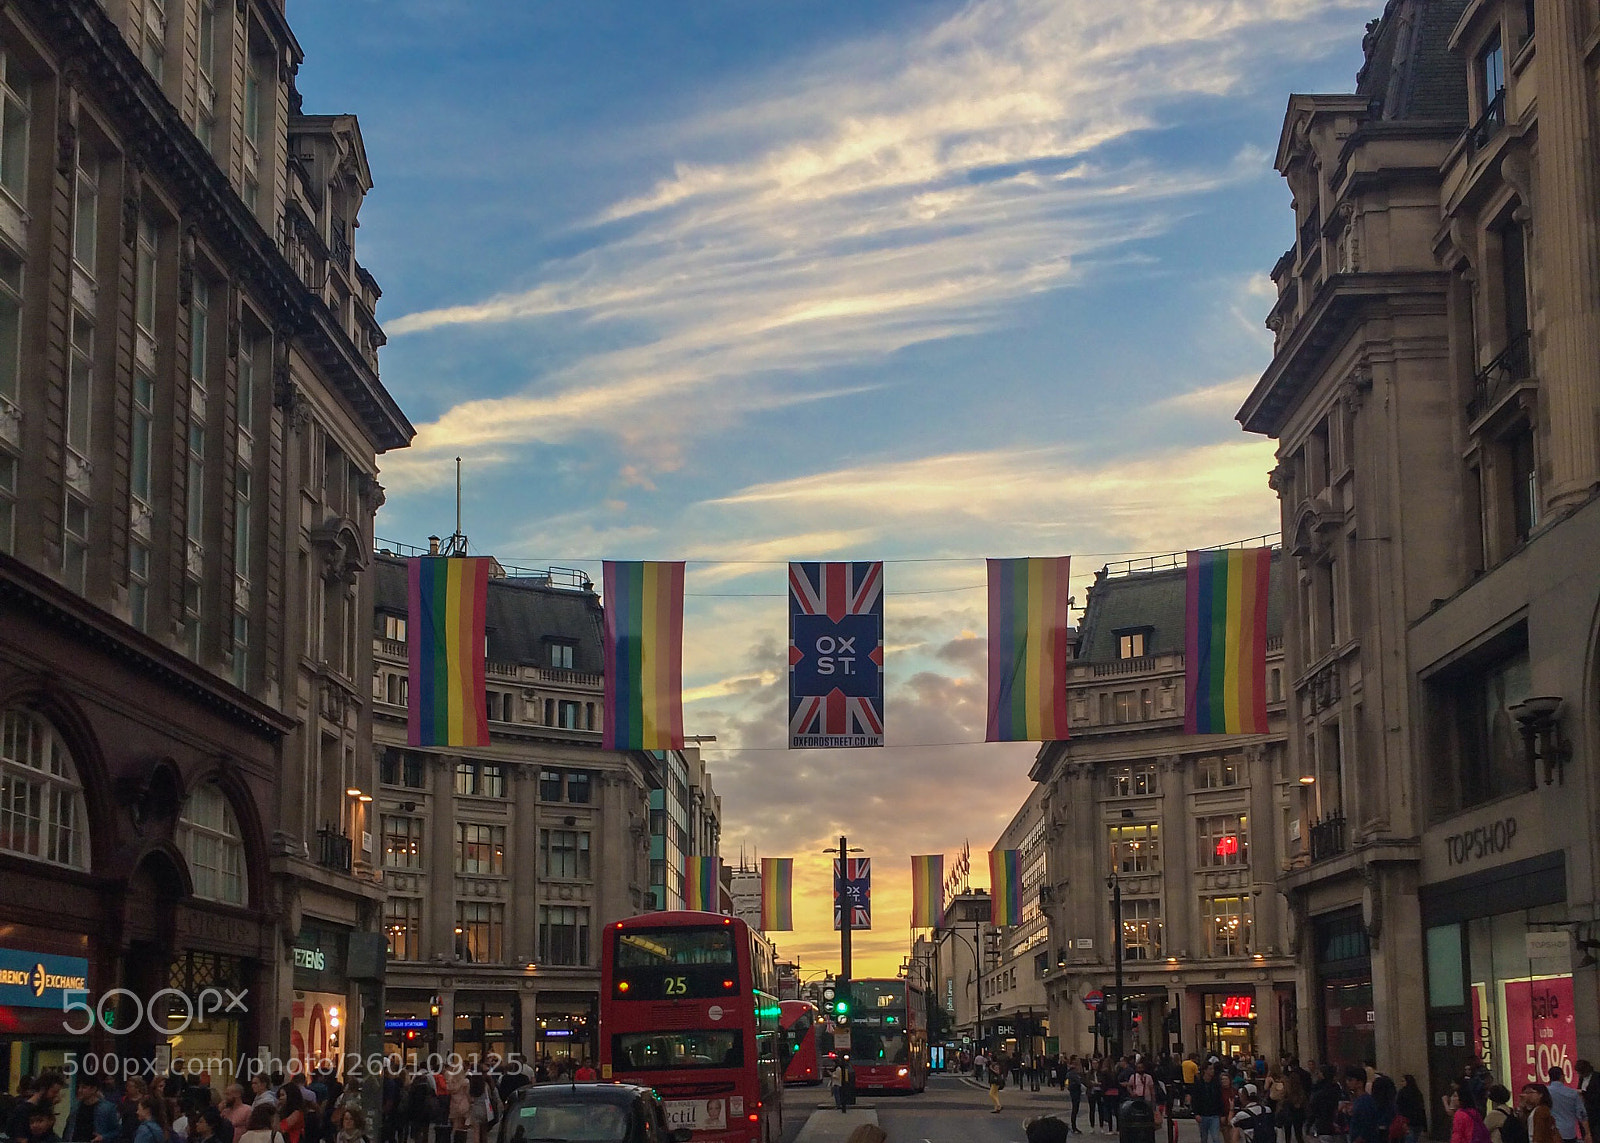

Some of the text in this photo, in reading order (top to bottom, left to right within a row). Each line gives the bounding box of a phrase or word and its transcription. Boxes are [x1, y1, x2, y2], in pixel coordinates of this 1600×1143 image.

[816, 636, 856, 655] OX
[818, 657, 856, 675] ST.
[793, 736, 879, 747] OXFORDSTREET.CO.UK
[1444, 817, 1517, 866] TOPSHOP
[46, 975, 85, 989] EXCHANGE
[665, 976, 687, 995] 25
[1526, 1043, 1573, 1084] 50%
